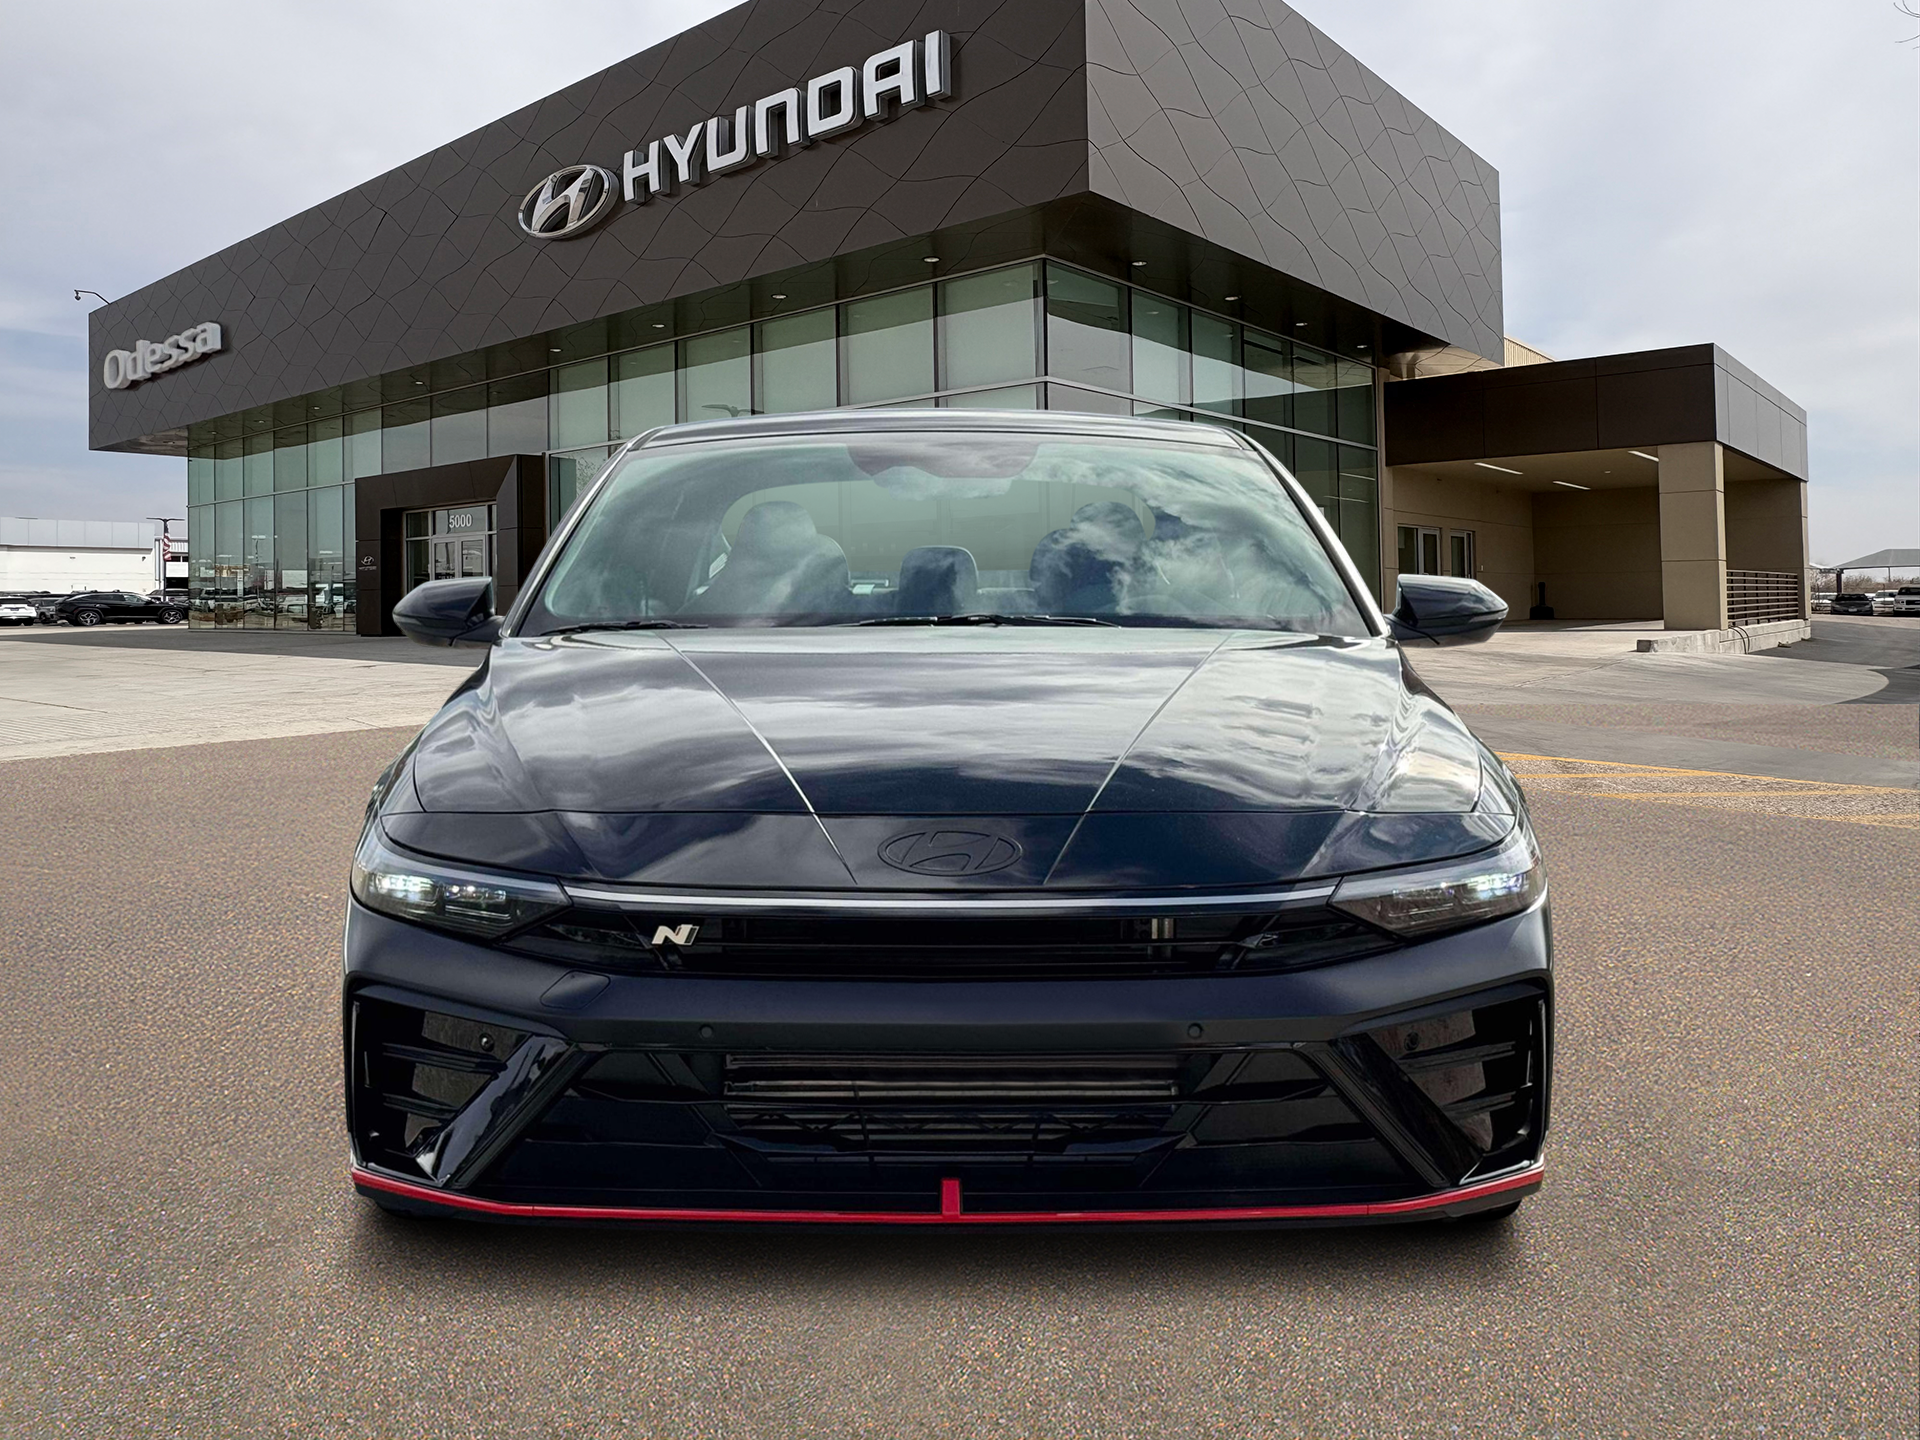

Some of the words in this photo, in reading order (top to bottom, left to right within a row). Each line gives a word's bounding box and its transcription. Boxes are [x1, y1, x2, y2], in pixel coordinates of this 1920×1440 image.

[623, 29, 951, 202] HYUNDAI
[104, 322, 222, 389] Odessa
[449, 514, 472, 528] 5000
